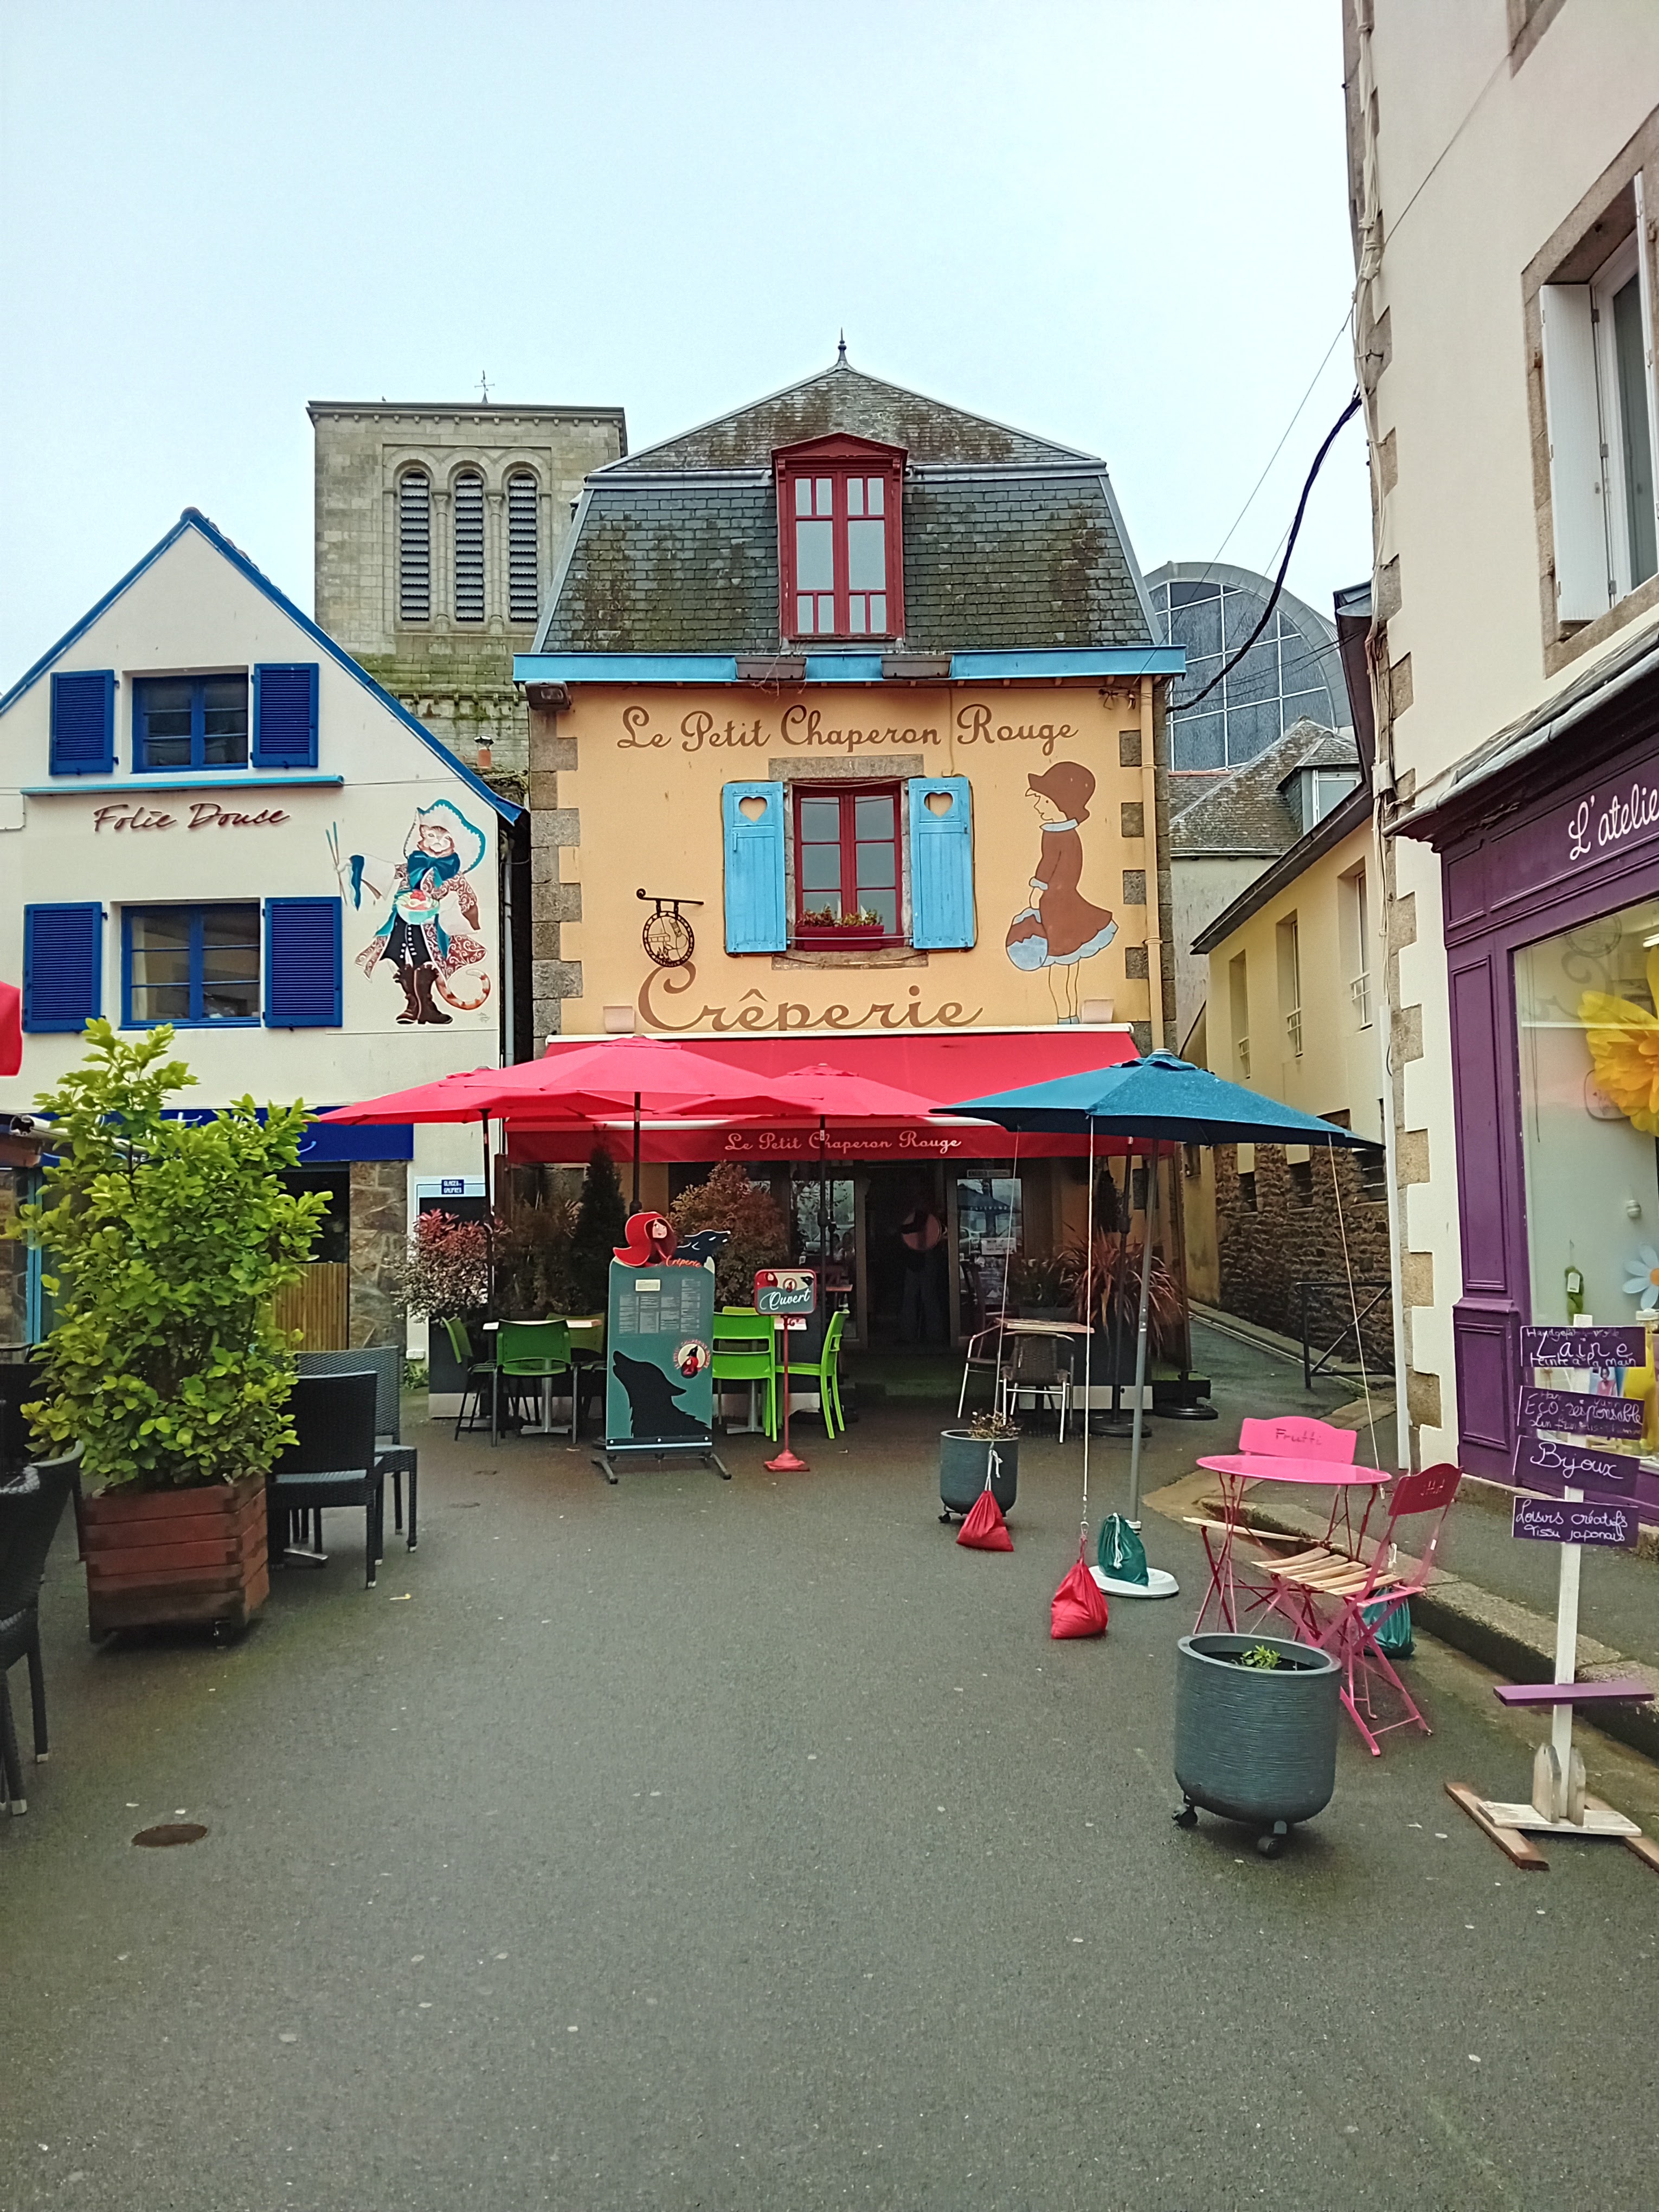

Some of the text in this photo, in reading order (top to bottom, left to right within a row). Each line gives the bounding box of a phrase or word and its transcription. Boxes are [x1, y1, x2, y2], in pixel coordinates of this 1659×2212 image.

[617, 703, 1079, 756] Le Petit Chaperon Rouge
[93, 803, 290, 832] Folie Douce
[638, 961, 983, 1031] Crêperie
[724, 1130, 962, 1154] Le Petit Chaperon Rouge
[760, 1288, 812, 1310] Ouvert
[1536, 1330, 1634, 1358] Laine
[1530, 1352, 1568, 1367] teinte
[1605, 1356, 1636, 1367] main
[1275, 1428, 1322, 1445] Frutti
[1530, 1442, 1624, 1478] Bijoux
[1515, 1499, 1628, 1538] Loisirs créatifs
[1523, 1525, 1625, 1542] Tissu japonais
